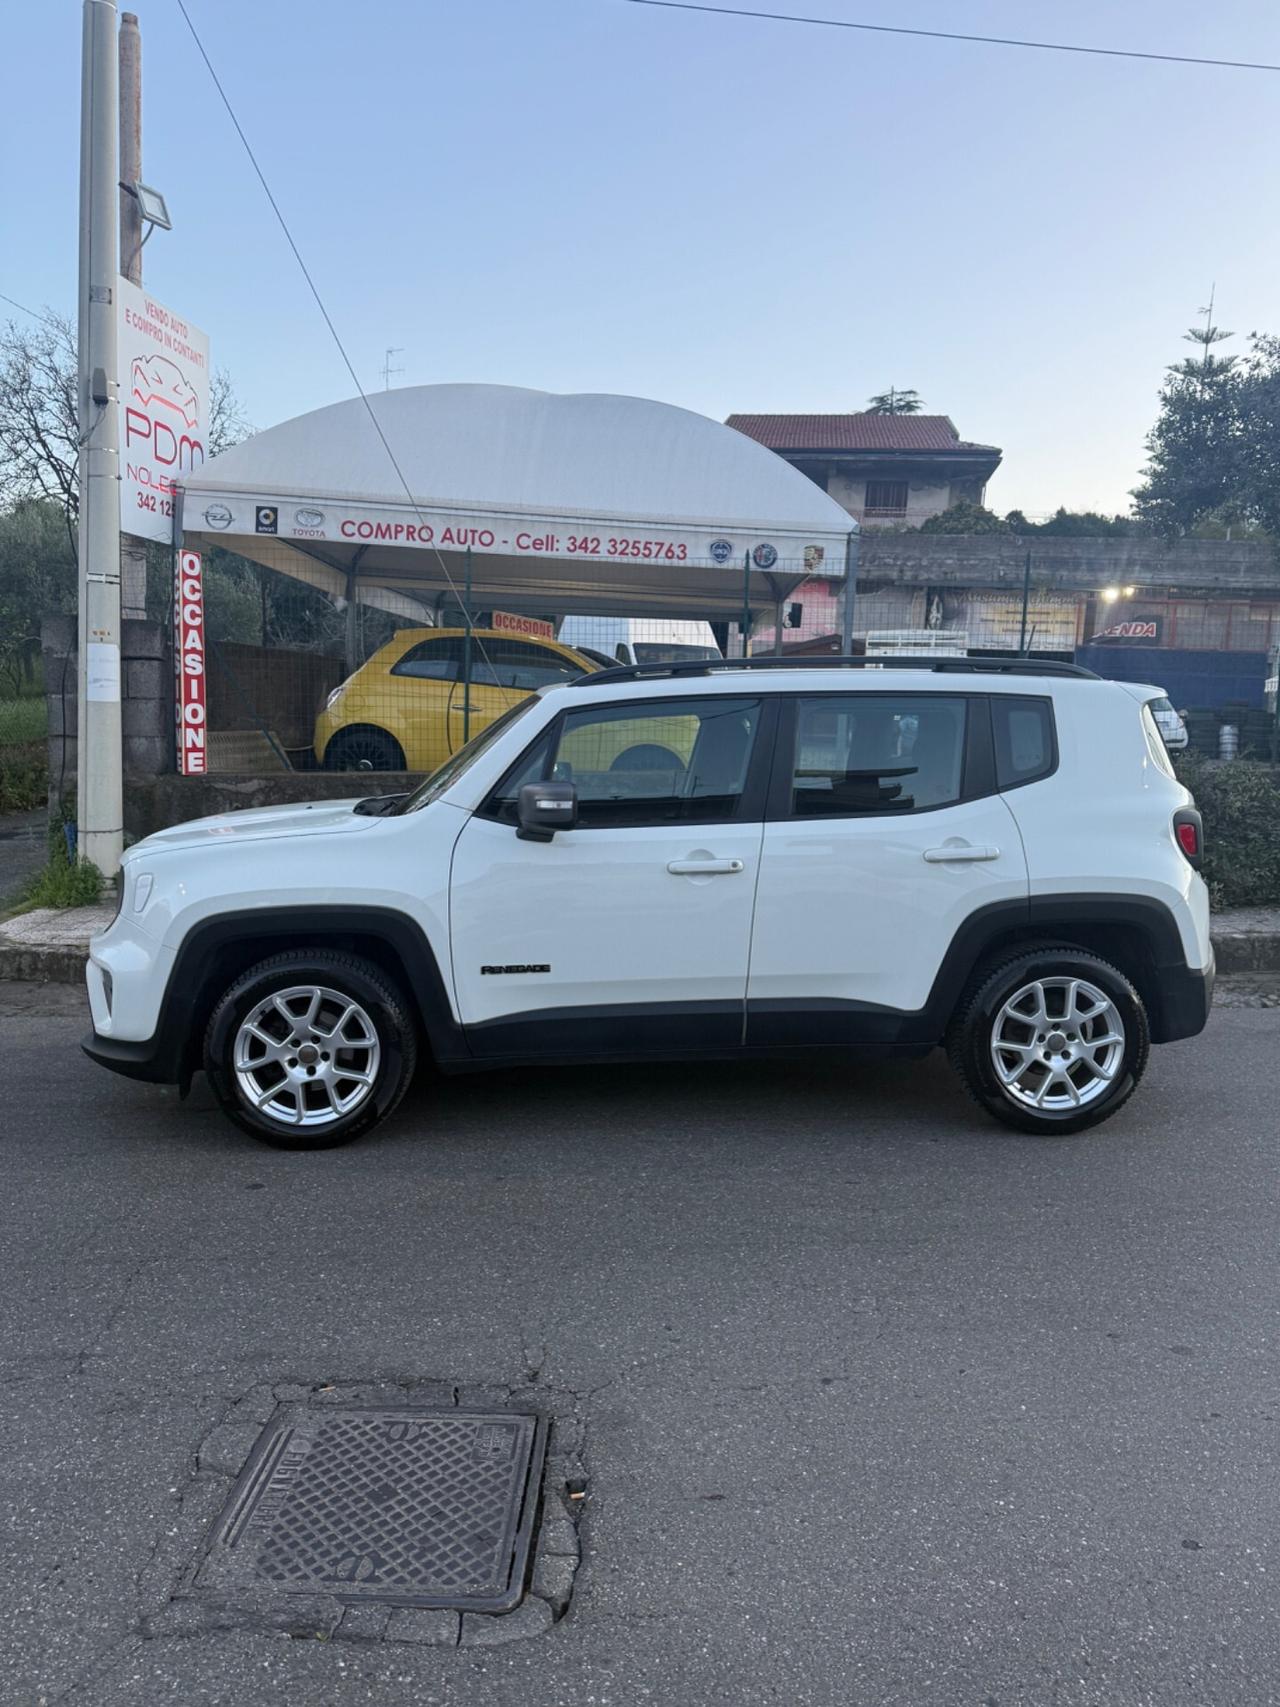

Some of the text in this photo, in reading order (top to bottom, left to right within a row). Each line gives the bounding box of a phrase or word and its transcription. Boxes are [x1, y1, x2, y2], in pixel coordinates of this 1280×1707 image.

[145, 300, 188, 339] VENDO AUTO
[125, 308, 204, 369] E COMPRO IN CONTANTI
[137, 491, 156, 512] 342
[292, 528, 327, 538] TOYOTA
[340, 520, 434, 543] COMPRO
[440, 527, 495, 548] AUTO
[516, 532, 560, 552] Cell:
[566, 535, 601, 555] 342
[607, 538, 687, 561] 3255763
[495, 614, 552, 638] OCCASIONE
[182, 553, 205, 773] OCCASIONE
[481, 964, 551, 976] RENEGADE
